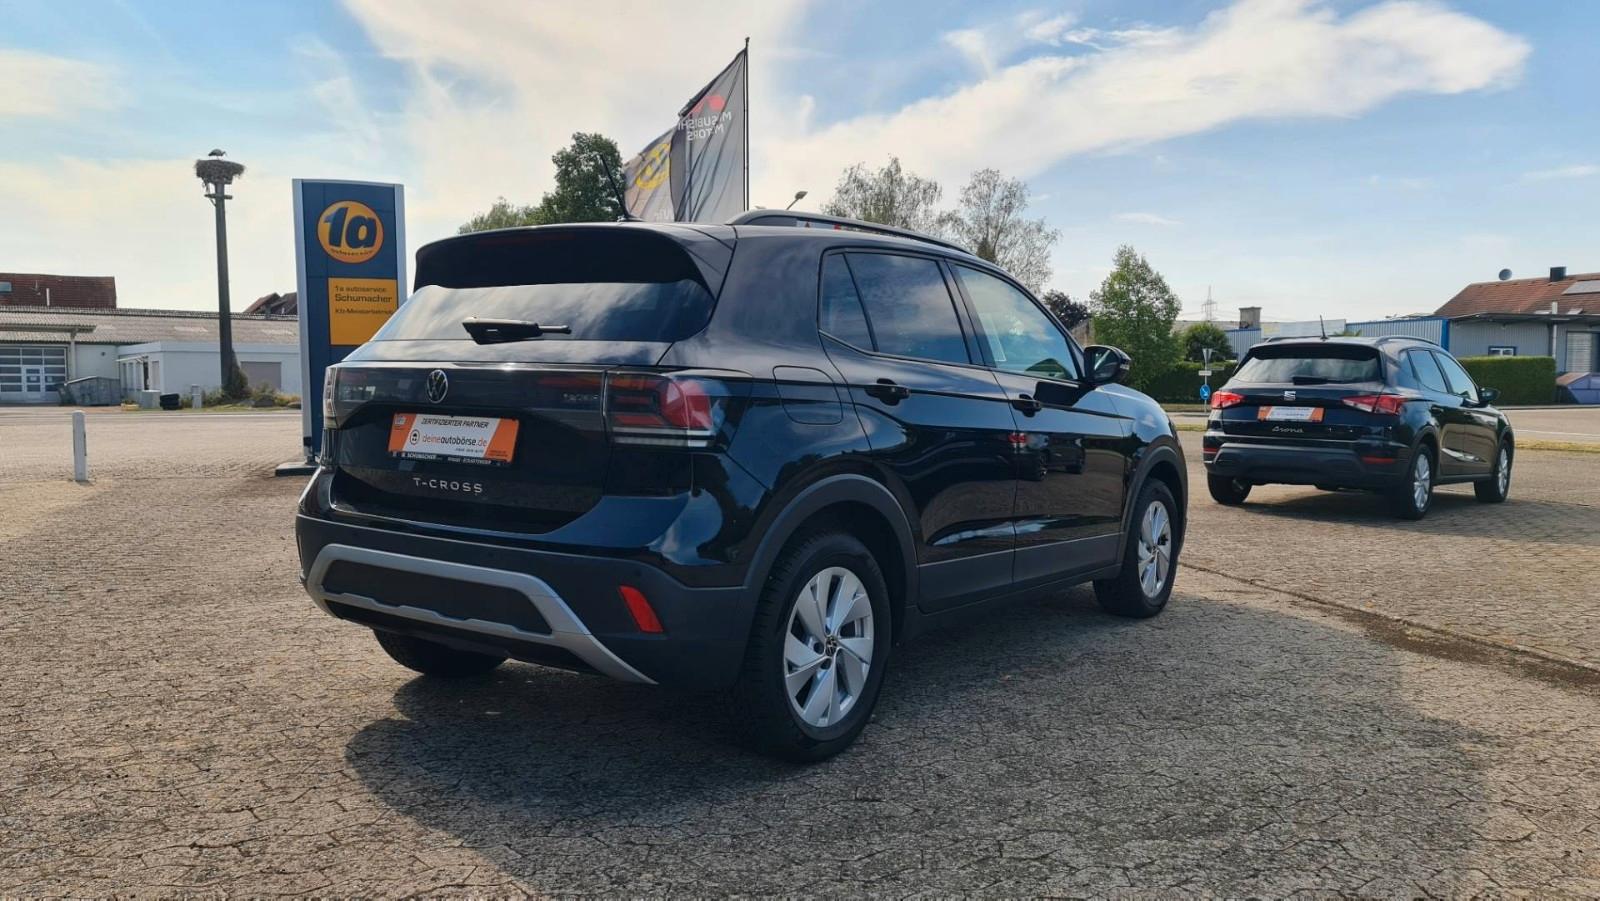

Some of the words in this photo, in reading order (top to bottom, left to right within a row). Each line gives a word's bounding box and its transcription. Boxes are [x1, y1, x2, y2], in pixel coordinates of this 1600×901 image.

[324, 206, 378, 249] 1a
[335, 293, 392, 303] Schumacher
[421, 418, 462, 427] ZERTIFIZIERTER
[462, 420, 489, 429] PARTNER
[423, 434, 488, 447] deineautobörse.de
[413, 477, 483, 493] T-CROSS
